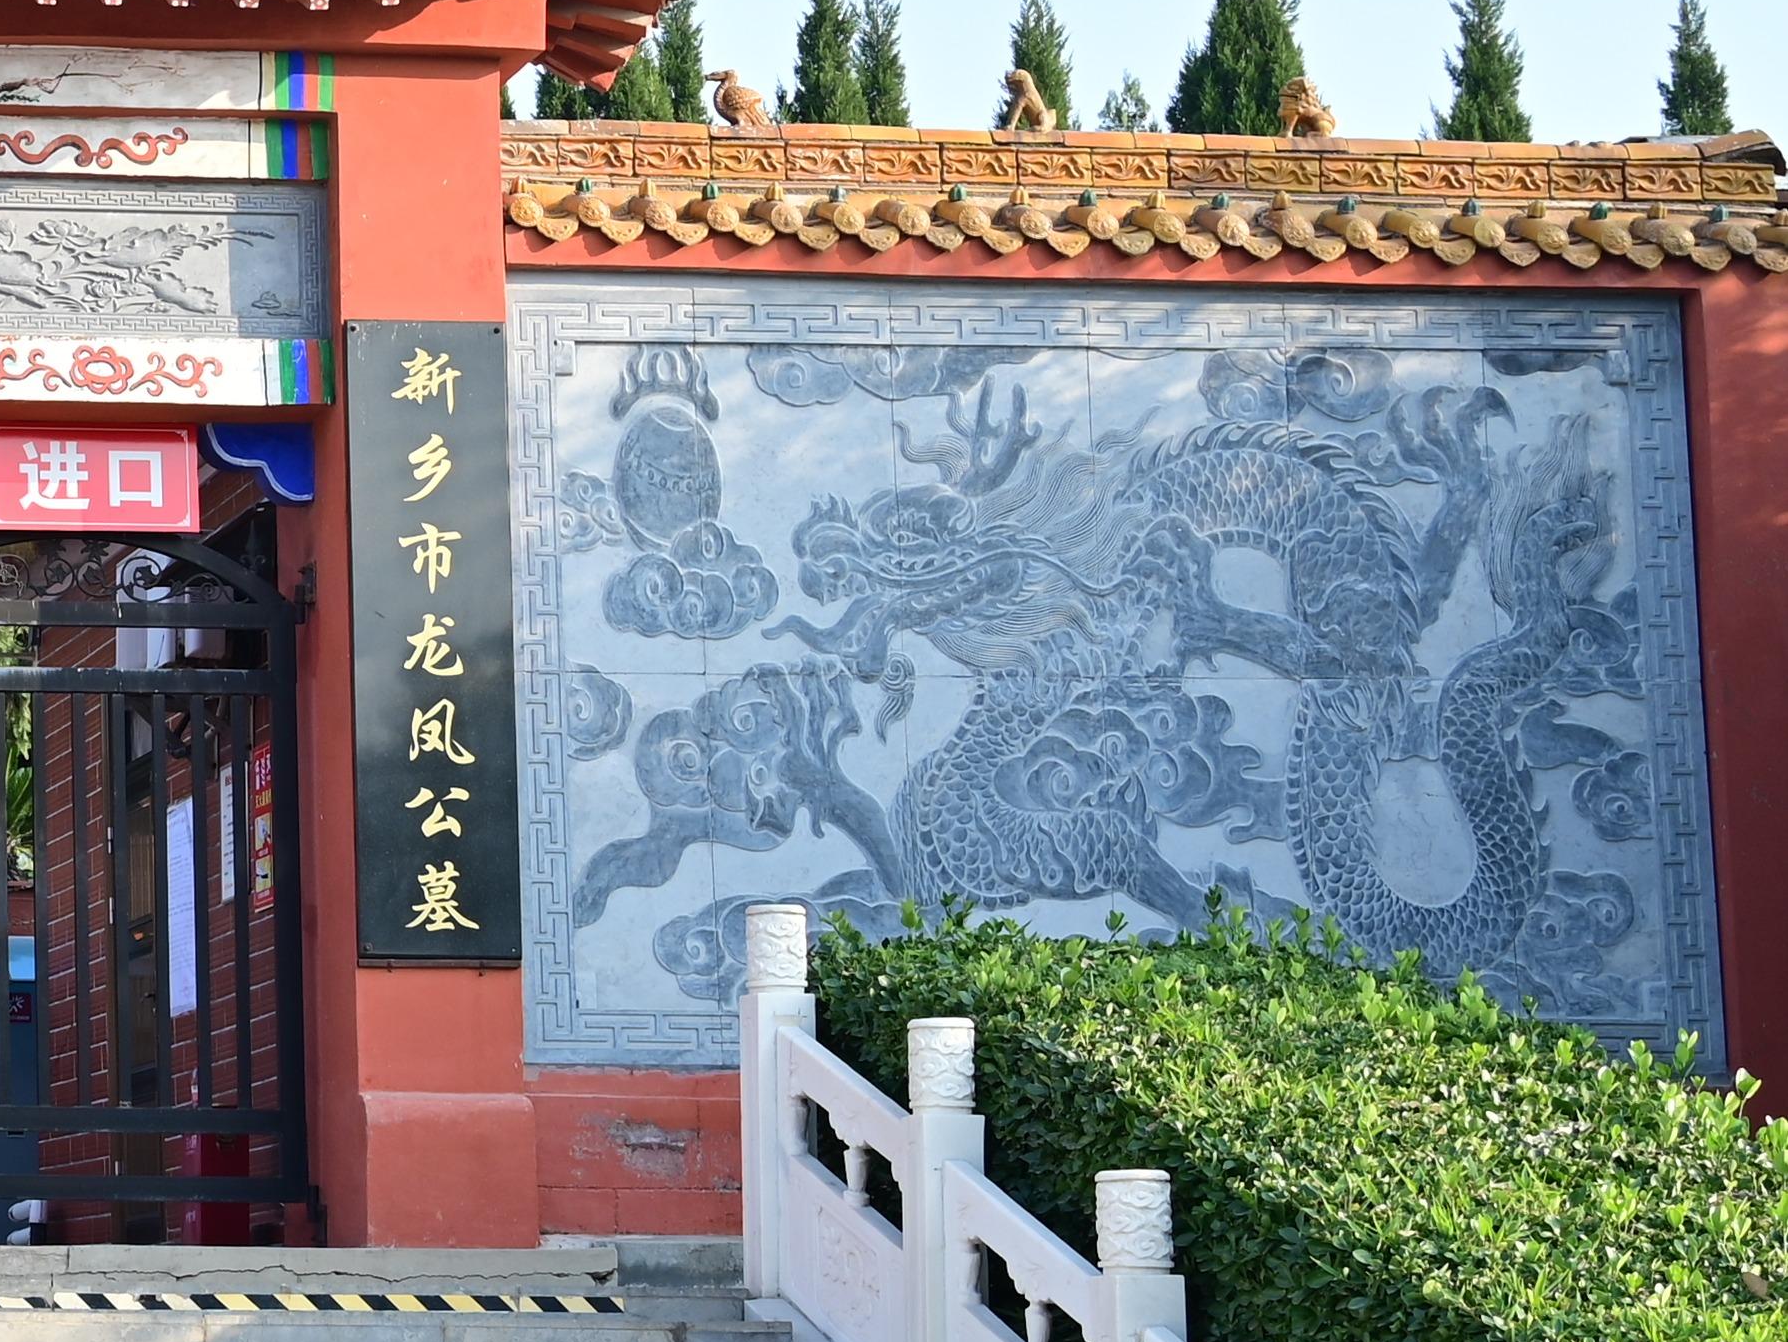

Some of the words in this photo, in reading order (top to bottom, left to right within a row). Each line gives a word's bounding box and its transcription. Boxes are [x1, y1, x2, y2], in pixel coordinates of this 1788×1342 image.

[19, 441, 164, 510] 进口
[390, 346, 480, 932] 新乡市龙凤公墓
